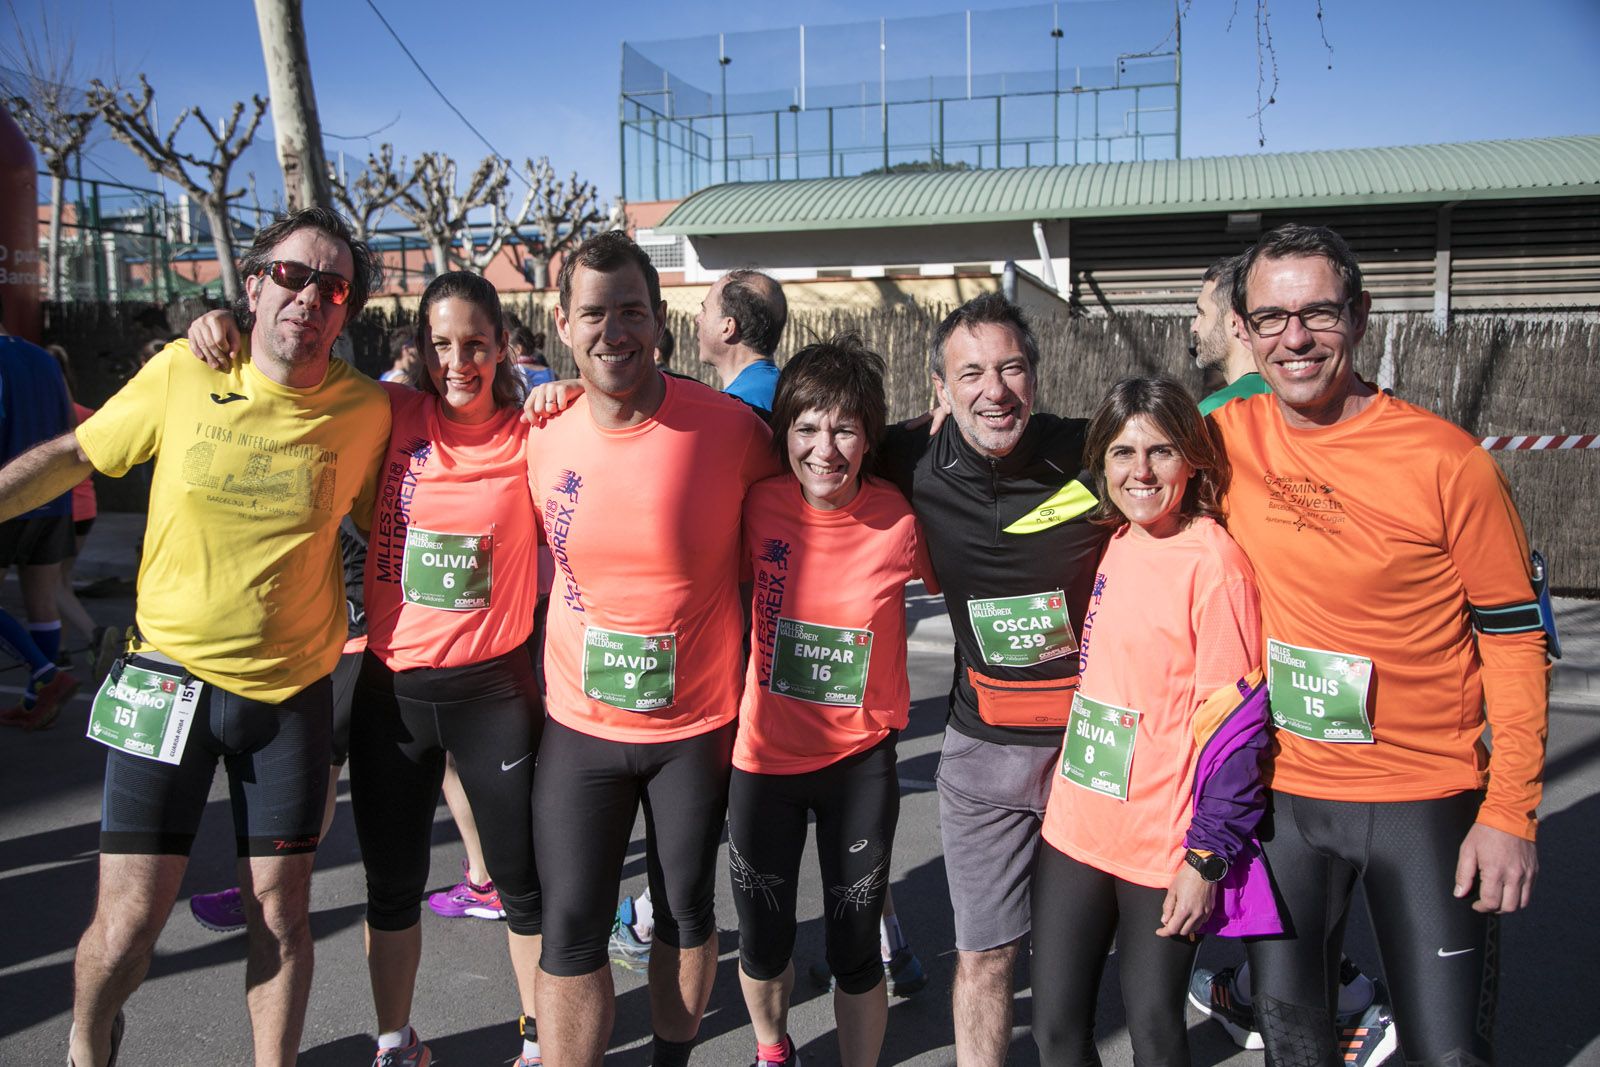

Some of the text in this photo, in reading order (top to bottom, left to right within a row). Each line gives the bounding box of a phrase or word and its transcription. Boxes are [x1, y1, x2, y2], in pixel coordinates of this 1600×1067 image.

[196, 422, 202, 436] V
[205, 424, 233, 444] CURSA
[1263, 475, 1317, 494] GARMIN
[377, 462, 405, 583] MILLES 2018
[421, 552, 479, 569] OLIVIA
[442, 572, 455, 589] 6
[971, 602, 995, 612] MILLES
[972, 607, 1012, 618] VALLDOREIX
[780, 621, 804, 632] MILLES
[992, 615, 1054, 633] OSCAR
[780, 628, 819, 642] VALLDOREIX
[1007, 633, 1046, 650] 239
[603, 652, 658, 670] DAVID
[794, 643, 854, 664] EMPAR
[624, 672, 636, 690] 9
[811, 663, 832, 682] 16
[1291, 671, 1339, 696] LLUIS
[181, 685, 196, 703] 151
[636, 698, 667, 706] COMPLEX
[1303, 695, 1326, 718] 15
[113, 705, 139, 729] 151
[1076, 718, 1116, 747] SÍLVIA
[1323, 728, 1363, 737] COMPLEX
[1084, 744, 1095, 765] 8
